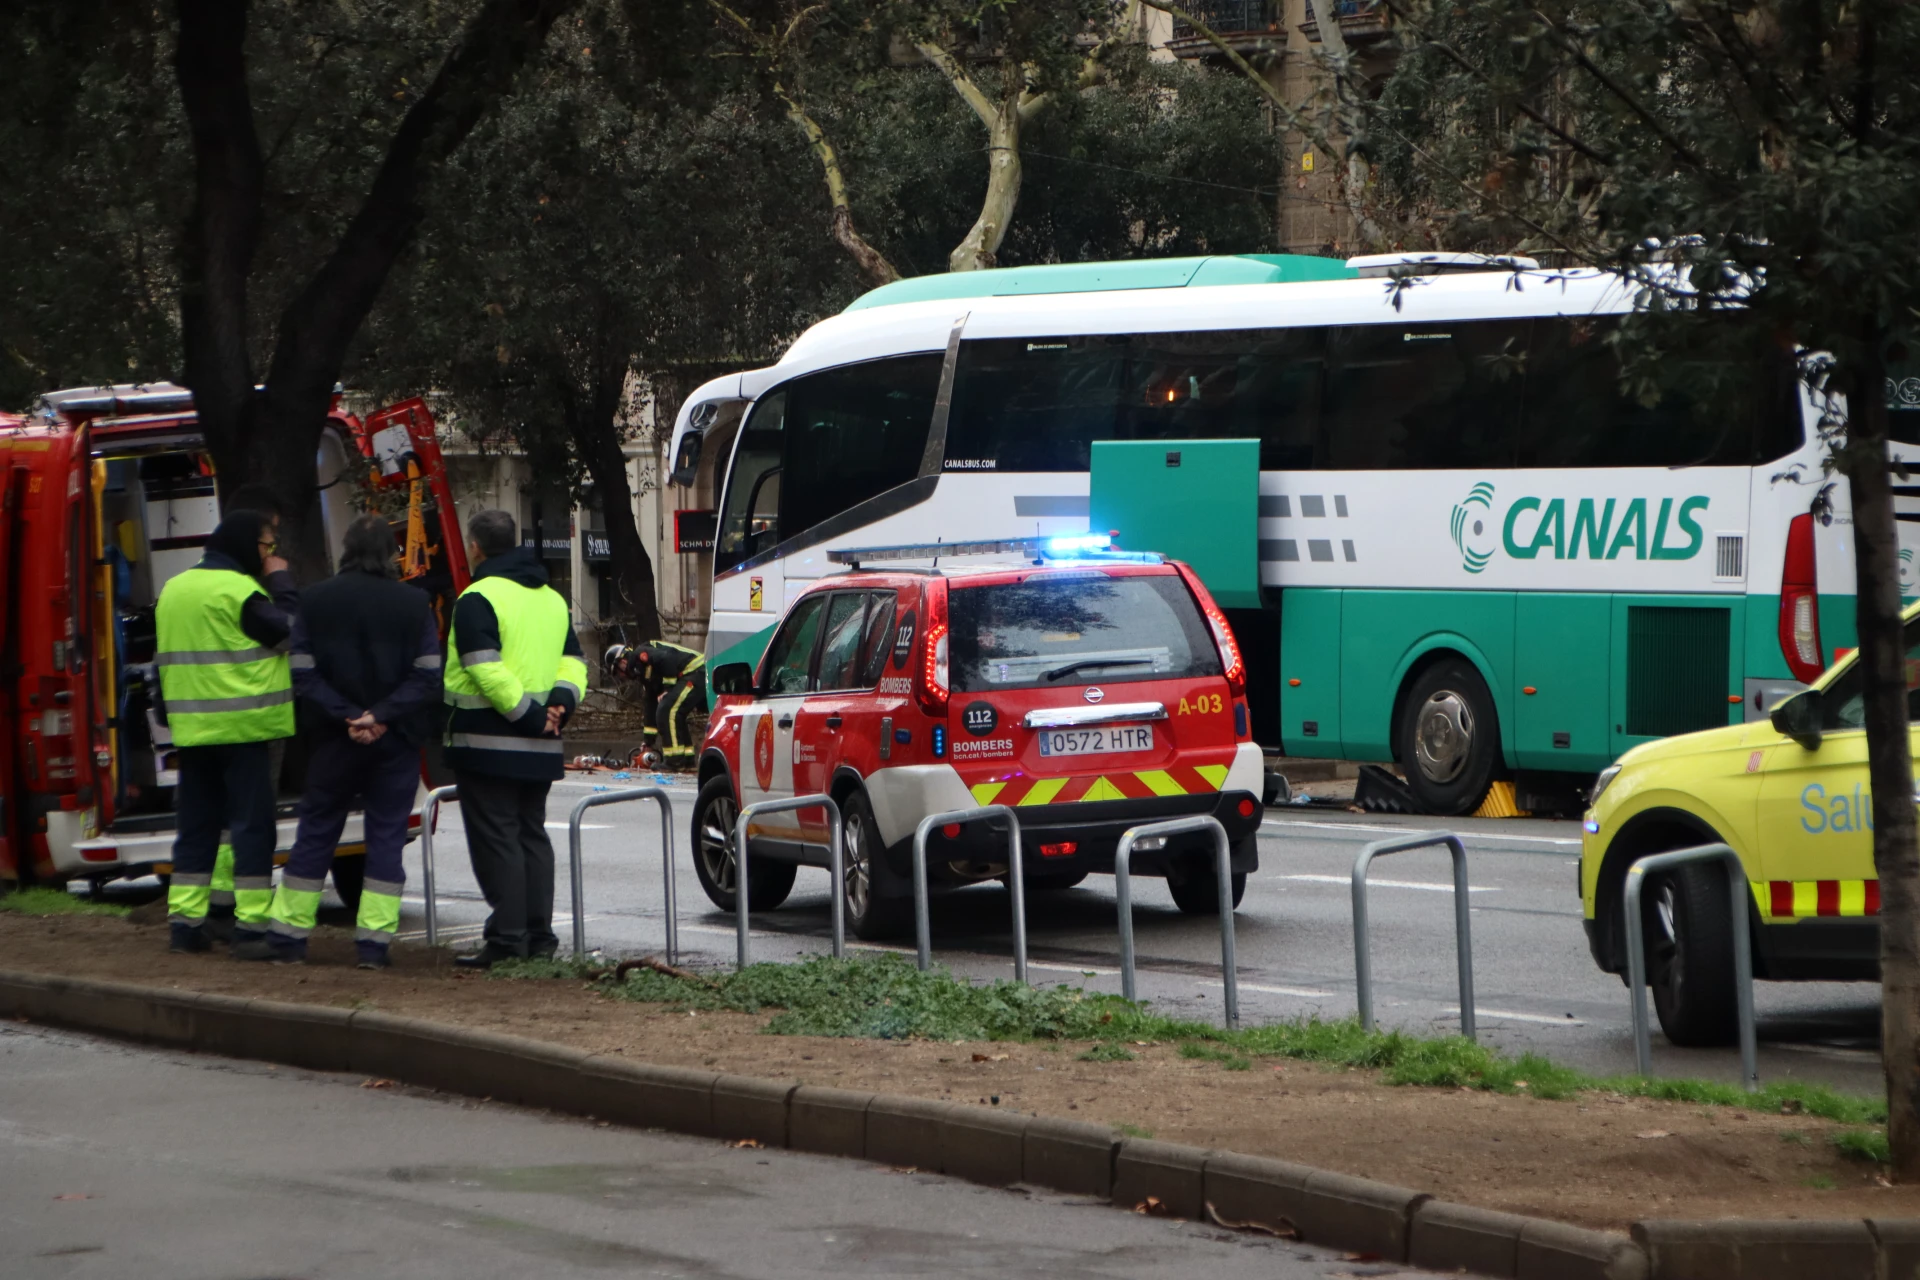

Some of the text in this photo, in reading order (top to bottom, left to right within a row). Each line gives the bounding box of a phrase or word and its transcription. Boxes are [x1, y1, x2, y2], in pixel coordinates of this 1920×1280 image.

[944, 459, 996, 469] CANALSBUS.COM
[1502, 495, 1711, 560] CANALS
[896, 625, 913, 647] 112
[880, 677, 913, 694] BOMBERS
[1177, 693, 1223, 716] A-03
[968, 709, 992, 724] 112
[953, 739, 1013, 753] BOMBERS
[1053, 728, 1148, 752] 0572 HTR
[953, 750, 1014, 760] bcn.cat/bombers
